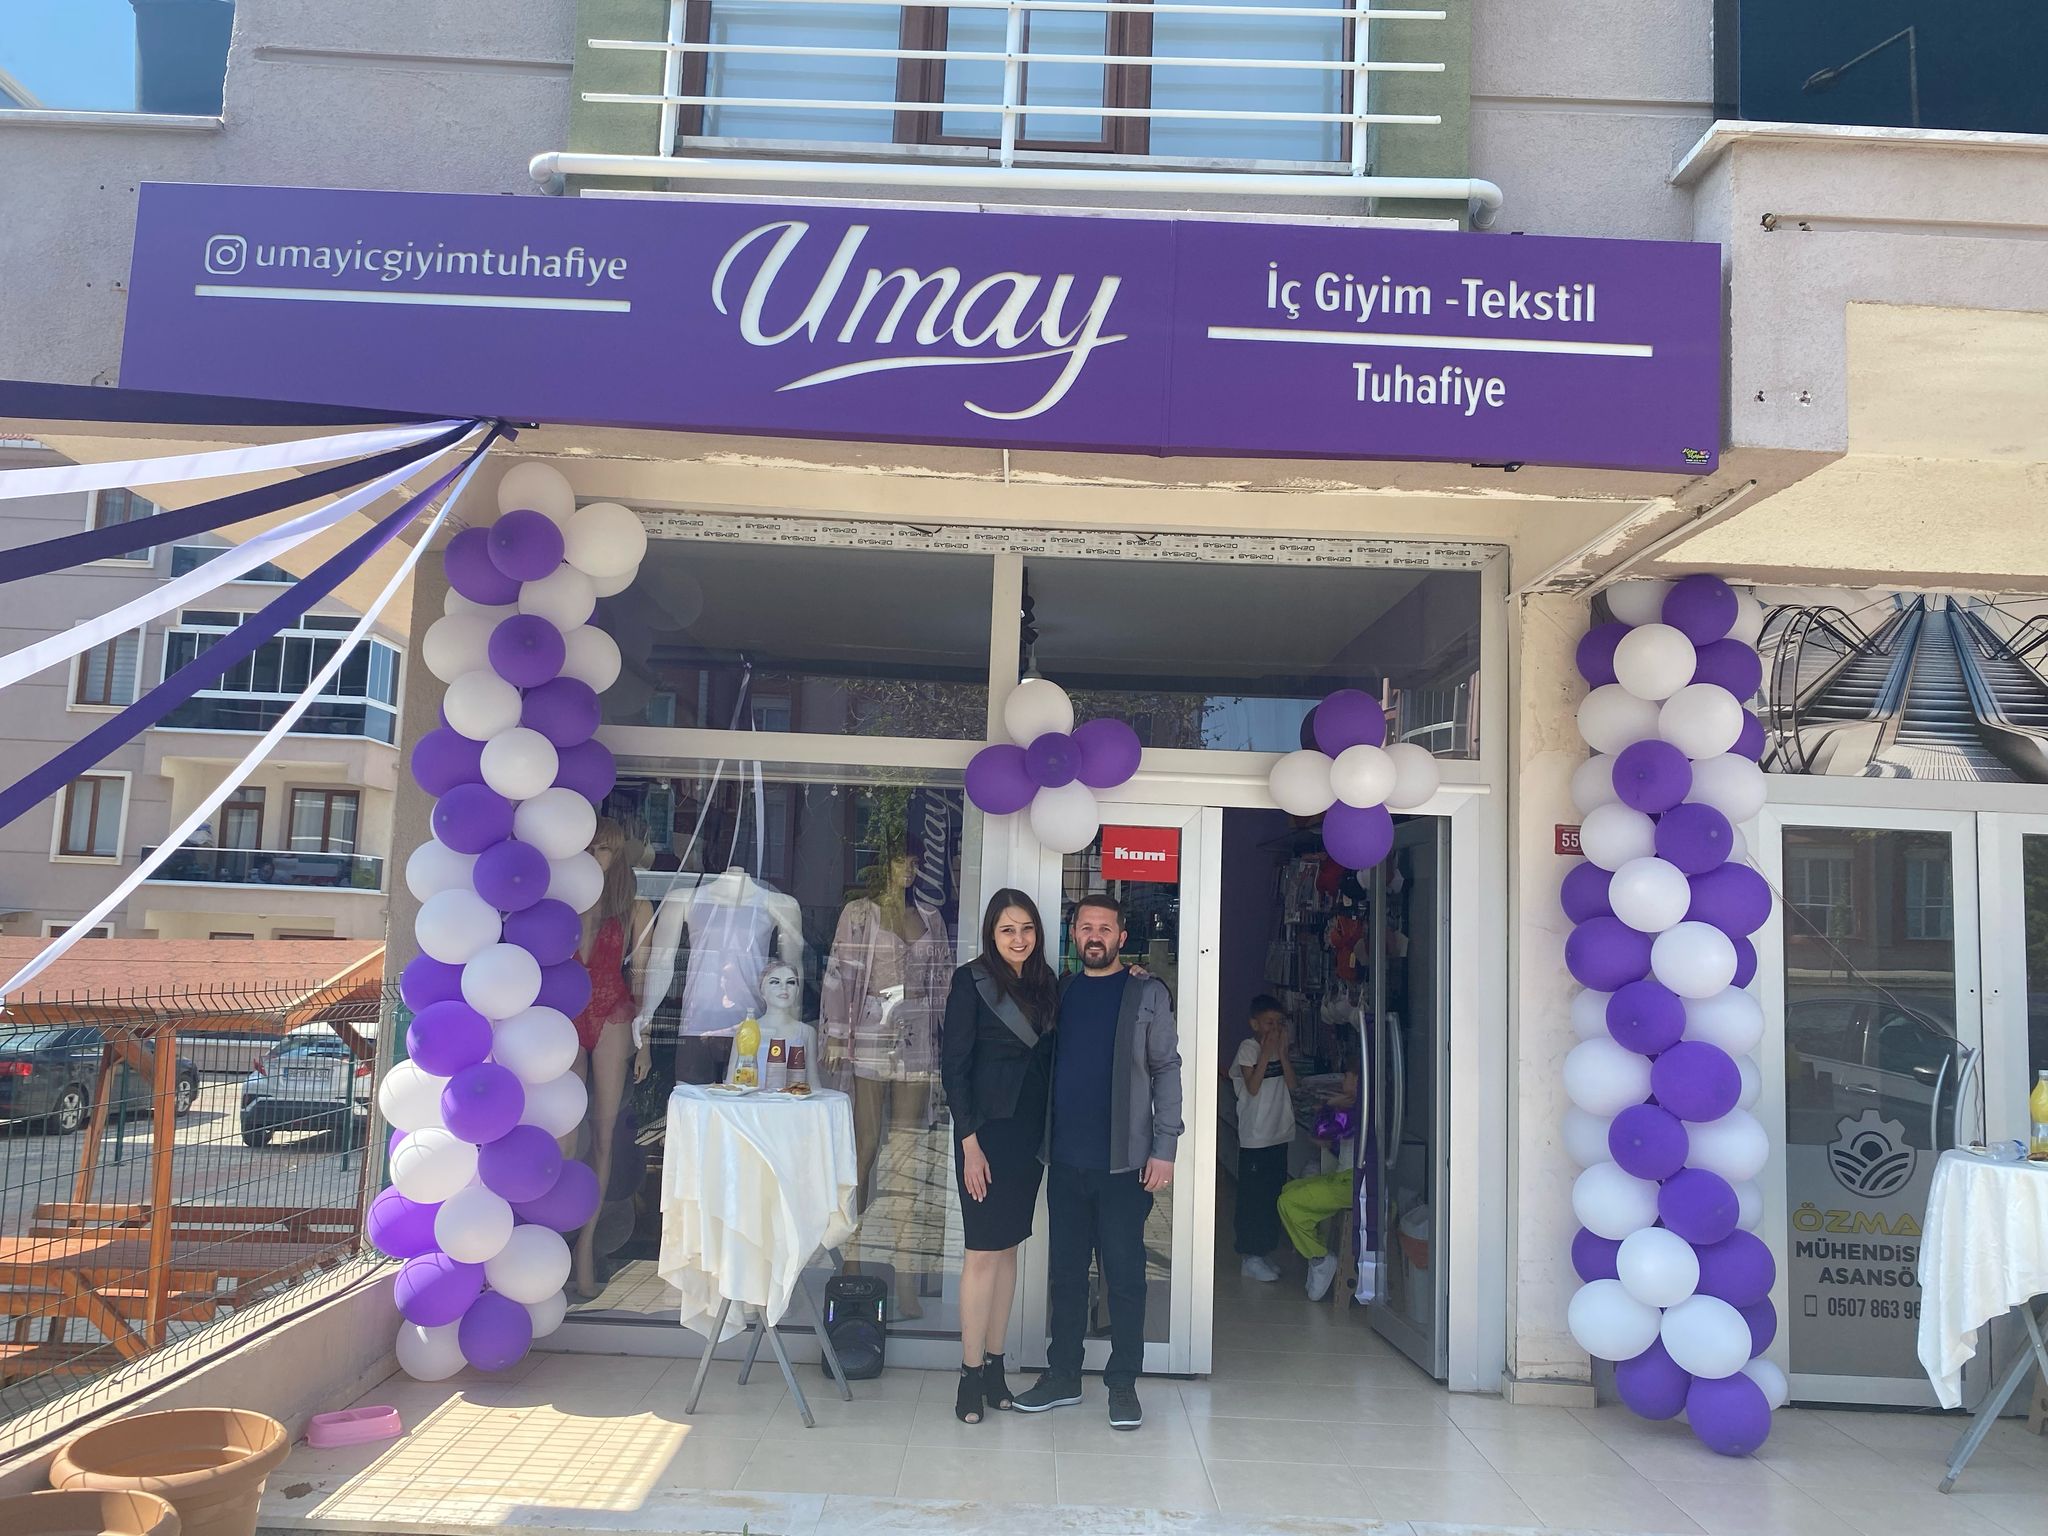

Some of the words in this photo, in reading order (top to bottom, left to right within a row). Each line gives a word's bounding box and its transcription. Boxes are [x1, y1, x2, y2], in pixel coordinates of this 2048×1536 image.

[255, 239, 628, 286] umayicgiyimtuhafiye
[1267, 262, 1300, 319] İç
[1315, 272, 1431, 323] Giyim
[711, 220, 1128, 420] Umay
[1353, 363, 1506, 416] Tuhafiye
[1114, 847, 1166, 861] Kom
[1819, 1266, 1922, 1288] ASANSÖ
[1828, 1297, 1866, 1317] 0507
[1870, 1300, 1900, 1319] 863
